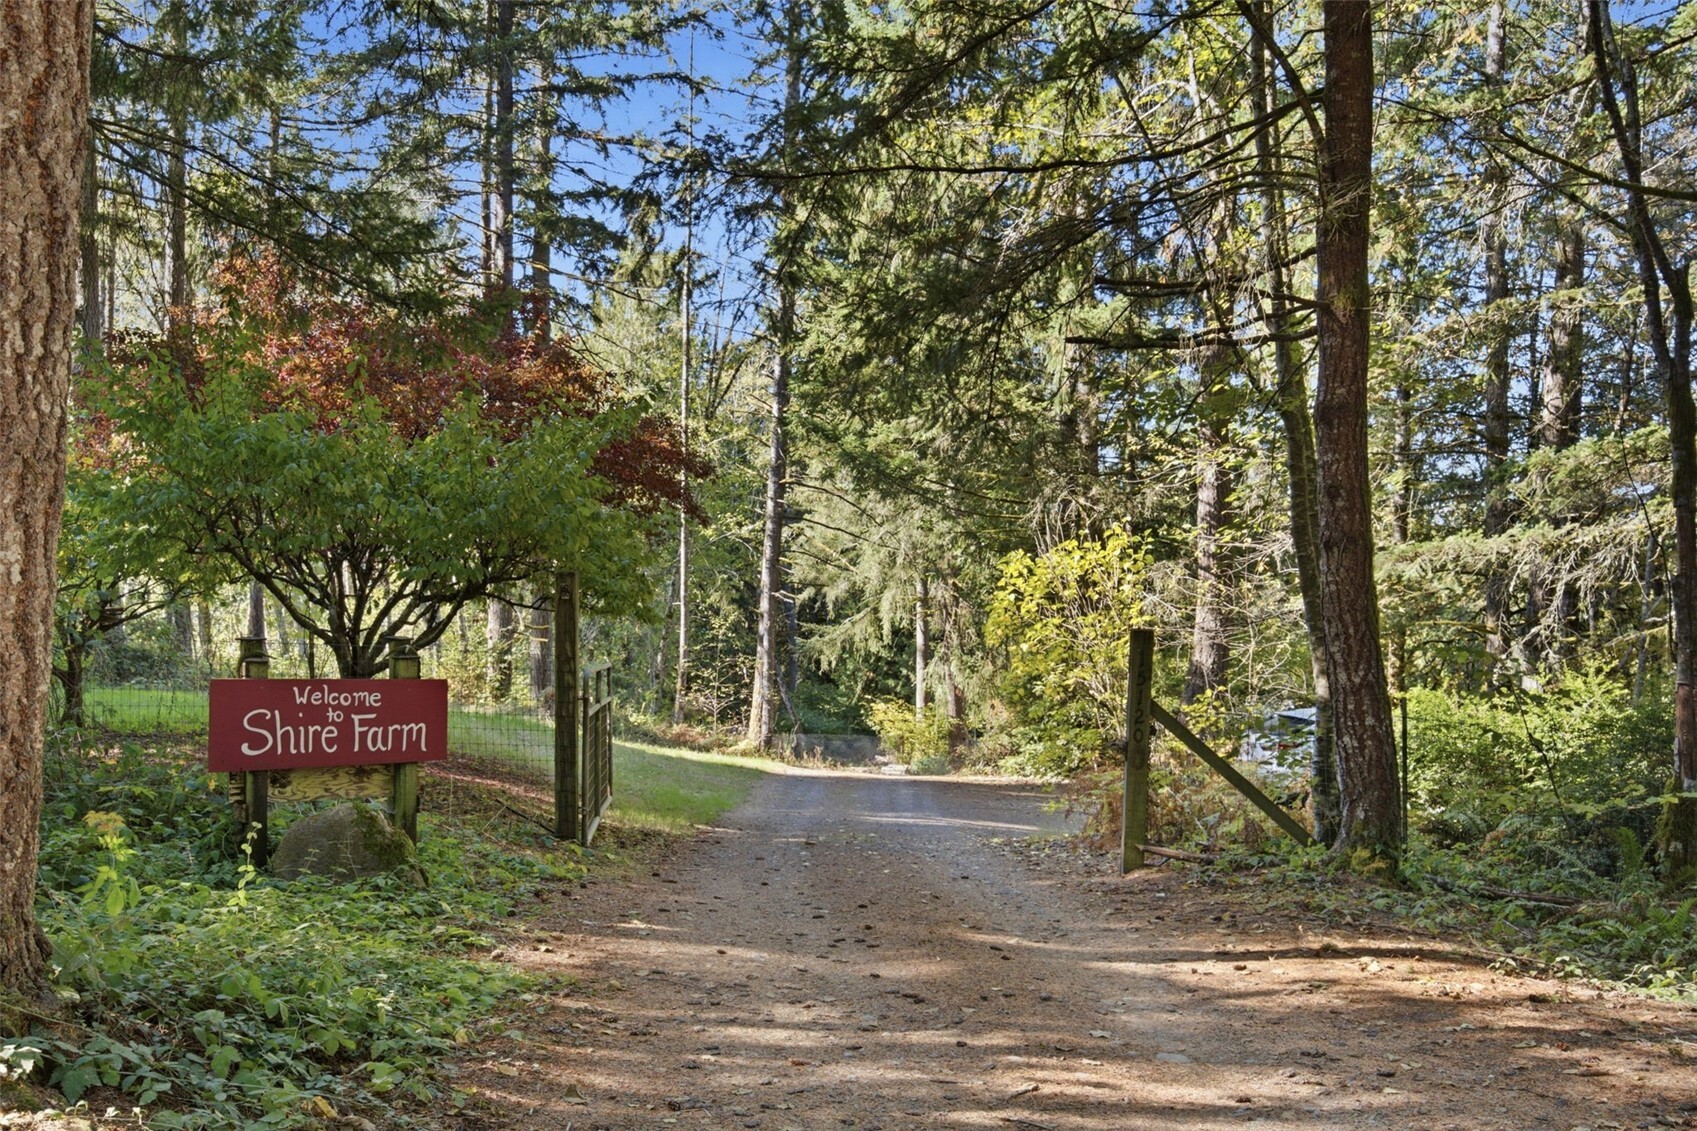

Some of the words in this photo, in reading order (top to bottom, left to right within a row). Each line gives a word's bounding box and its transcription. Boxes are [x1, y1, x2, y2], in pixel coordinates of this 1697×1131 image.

[293, 684, 382, 707] Welcome
[326, 707, 344, 723] to
[240, 708, 338, 756] Shire
[351, 713, 427, 752] Farm
